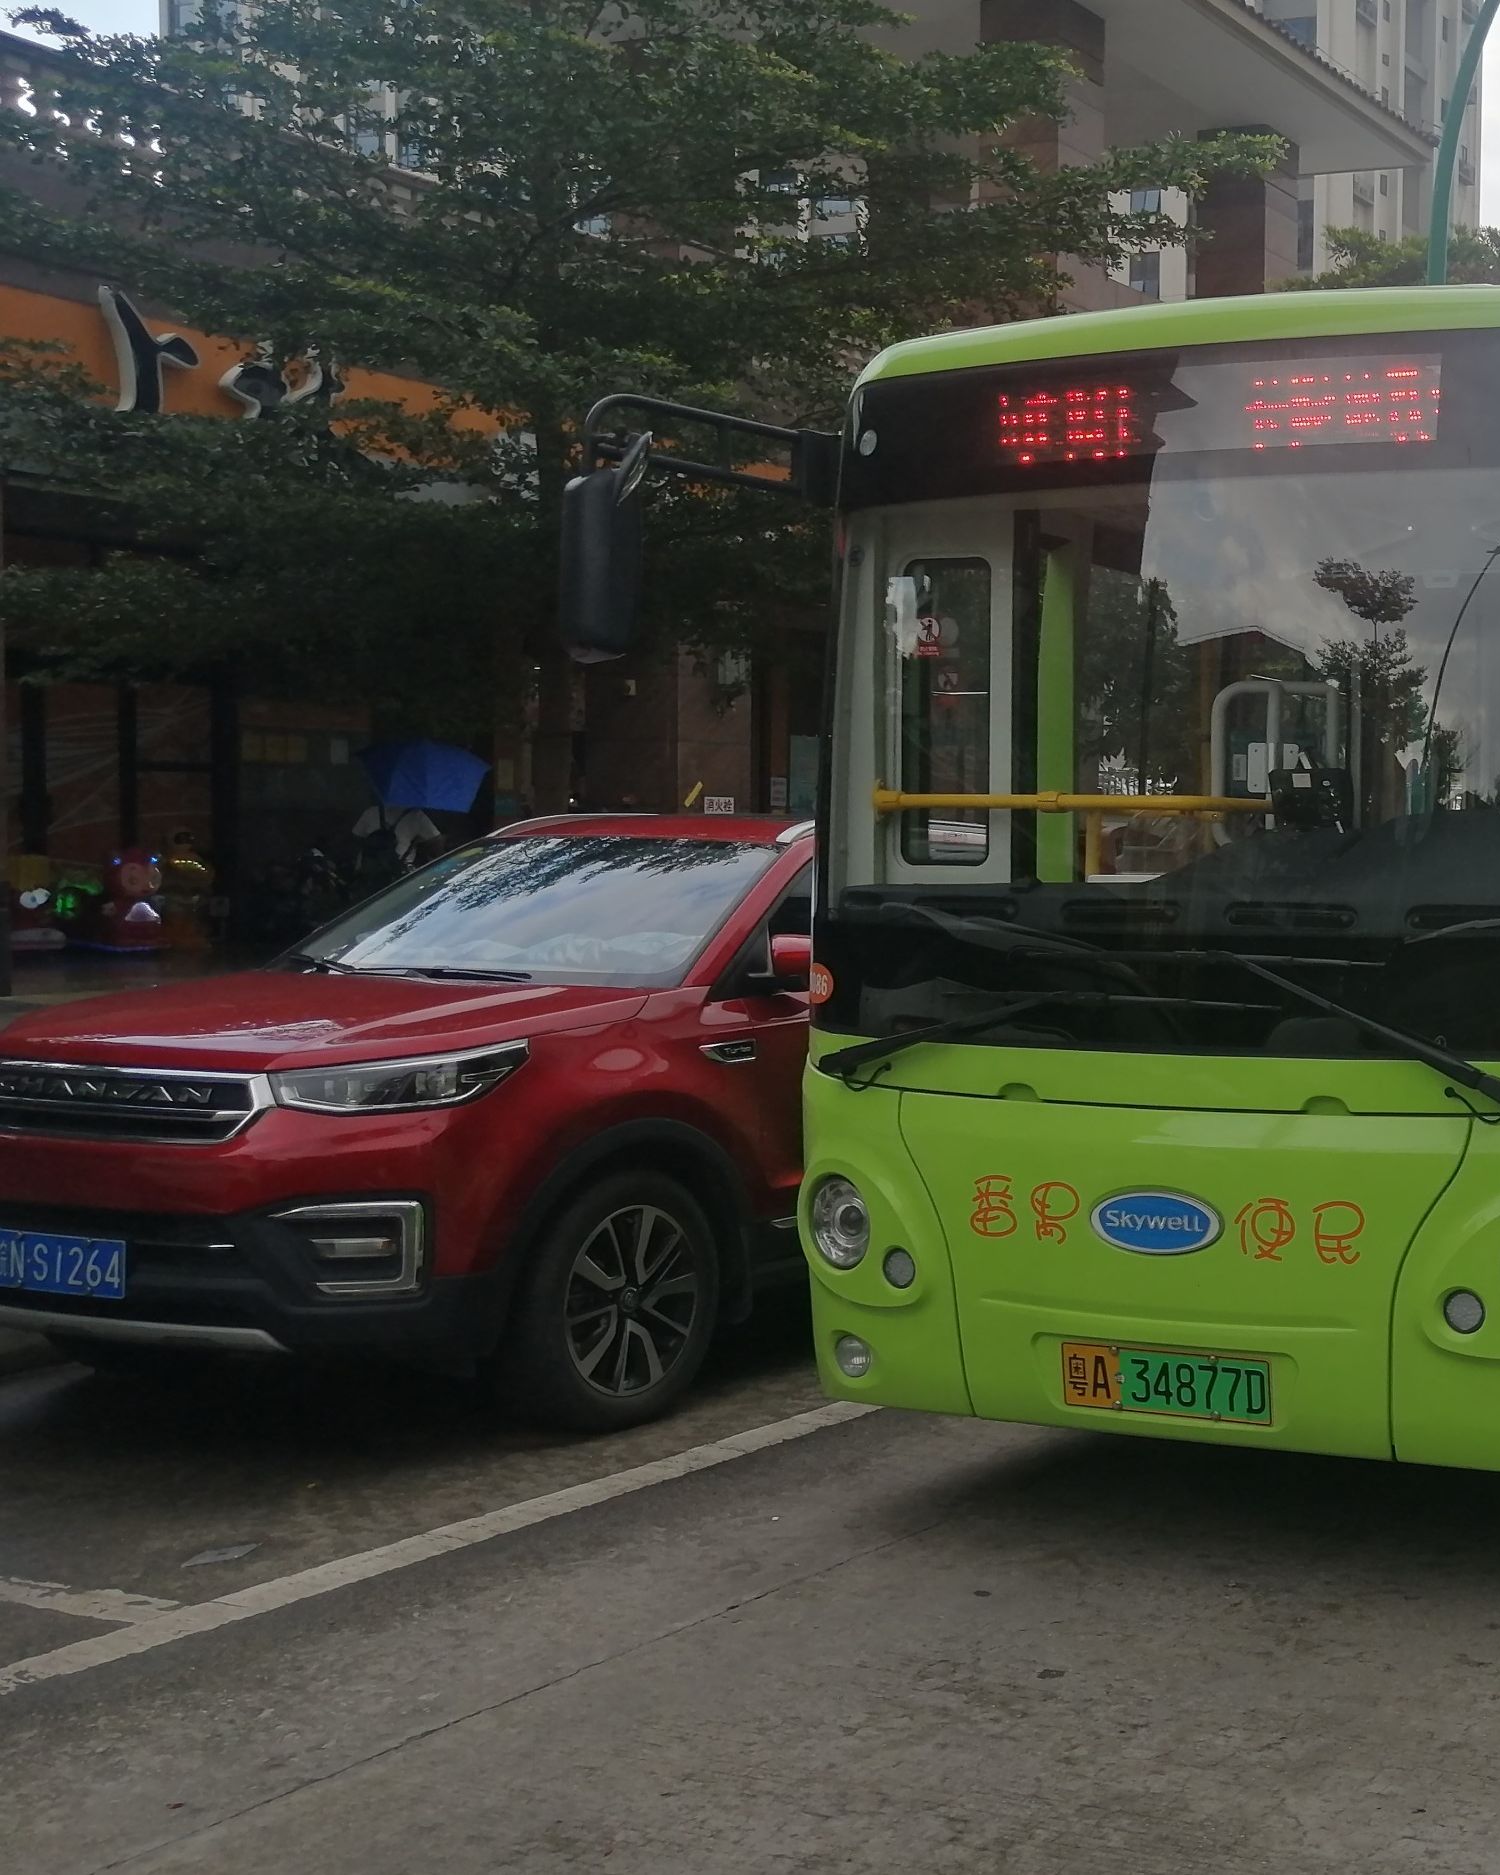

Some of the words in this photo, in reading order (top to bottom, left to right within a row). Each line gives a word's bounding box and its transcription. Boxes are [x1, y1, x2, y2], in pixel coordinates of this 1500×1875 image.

[705, 798, 733, 812] 消火栓
[1104, 1208, 1204, 1233] Skywell
[1234, 1197, 1366, 1265] 便民
